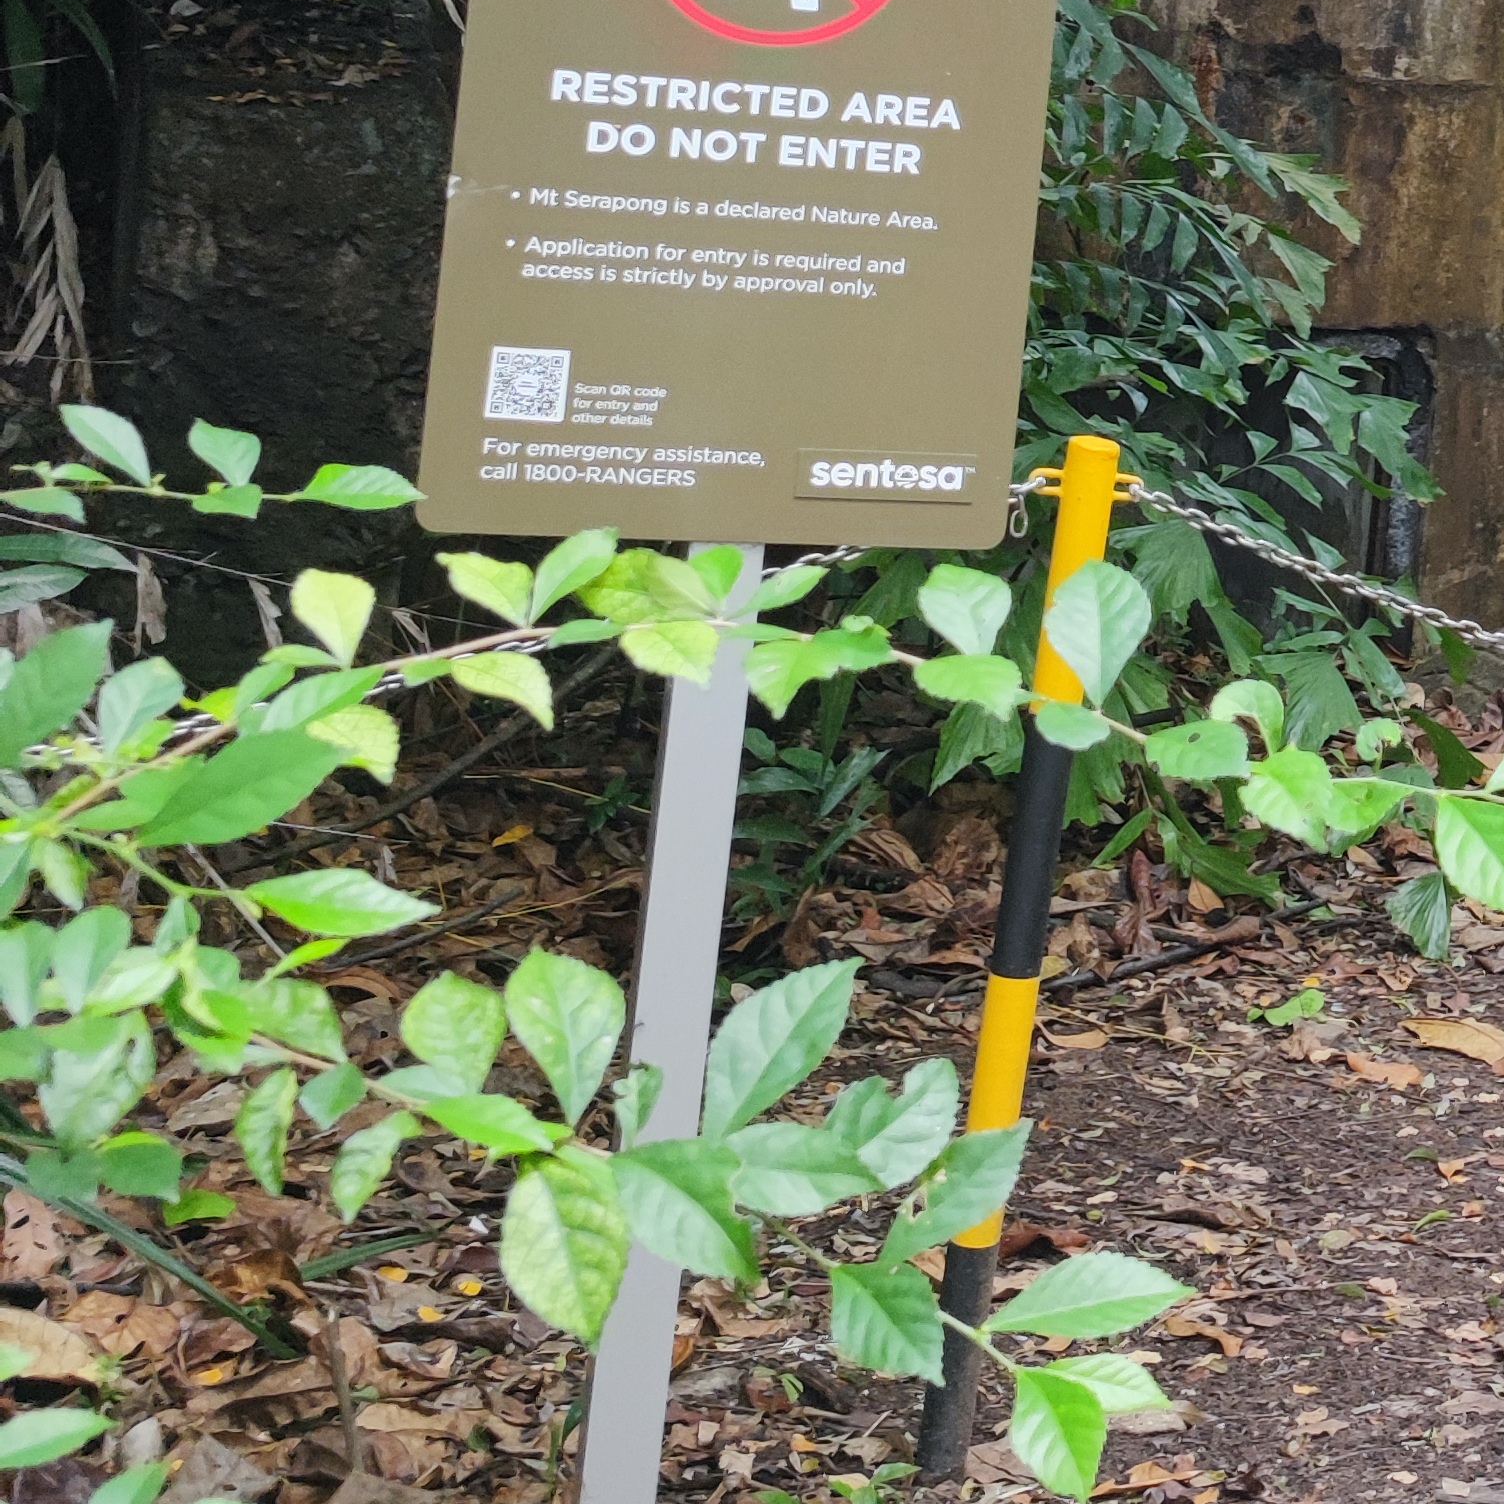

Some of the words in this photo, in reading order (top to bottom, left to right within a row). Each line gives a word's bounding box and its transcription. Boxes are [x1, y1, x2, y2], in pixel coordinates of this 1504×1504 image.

[550, 68, 830, 120] RESTRICTED
[841, 91, 961, 130] AREA
[586, 121, 656, 155] DO
[670, 127, 766, 163] NOT
[779, 135, 921, 174] ENTER
[529, 187, 559, 207] Mt
[565, 190, 668, 215] Serapong
[674, 196, 691, 214] is
[696, 201, 709, 216] a
[715, 200, 805, 222] declared
[811, 207, 880, 226] Nature
[887, 211, 939, 230] Area.
[525, 236, 649, 260] Application
[655, 244, 685, 262] for
[693, 248, 747, 268] entry
[753, 250, 769, 266] is
[775, 252, 861, 276] required
[868, 258, 906, 275] and
[521, 262, 594, 281] access
[600, 264, 617, 282] is
[622, 266, 695, 289] strictly
[702, 269, 729, 290] by
[734, 272, 823, 293] approval
[831, 277, 878, 299] only.
[572, 398, 592, 409] for
[595, 400, 630, 412] entry
[633, 401, 658, 412] and
[574, 383, 606, 395] Scan
[610, 384, 631, 397] QR
[634, 386, 668, 398] code
[571, 413, 607, 424] other
[612, 414, 653, 426] details
[482, 437, 522, 456] For
[526, 442, 648, 463] emergency
[653, 445, 766, 468] assistance,
[480, 462, 518, 480] call
[524, 464, 696, 486] 1800-RANGERS
[811, 459, 964, 491] sentosa
